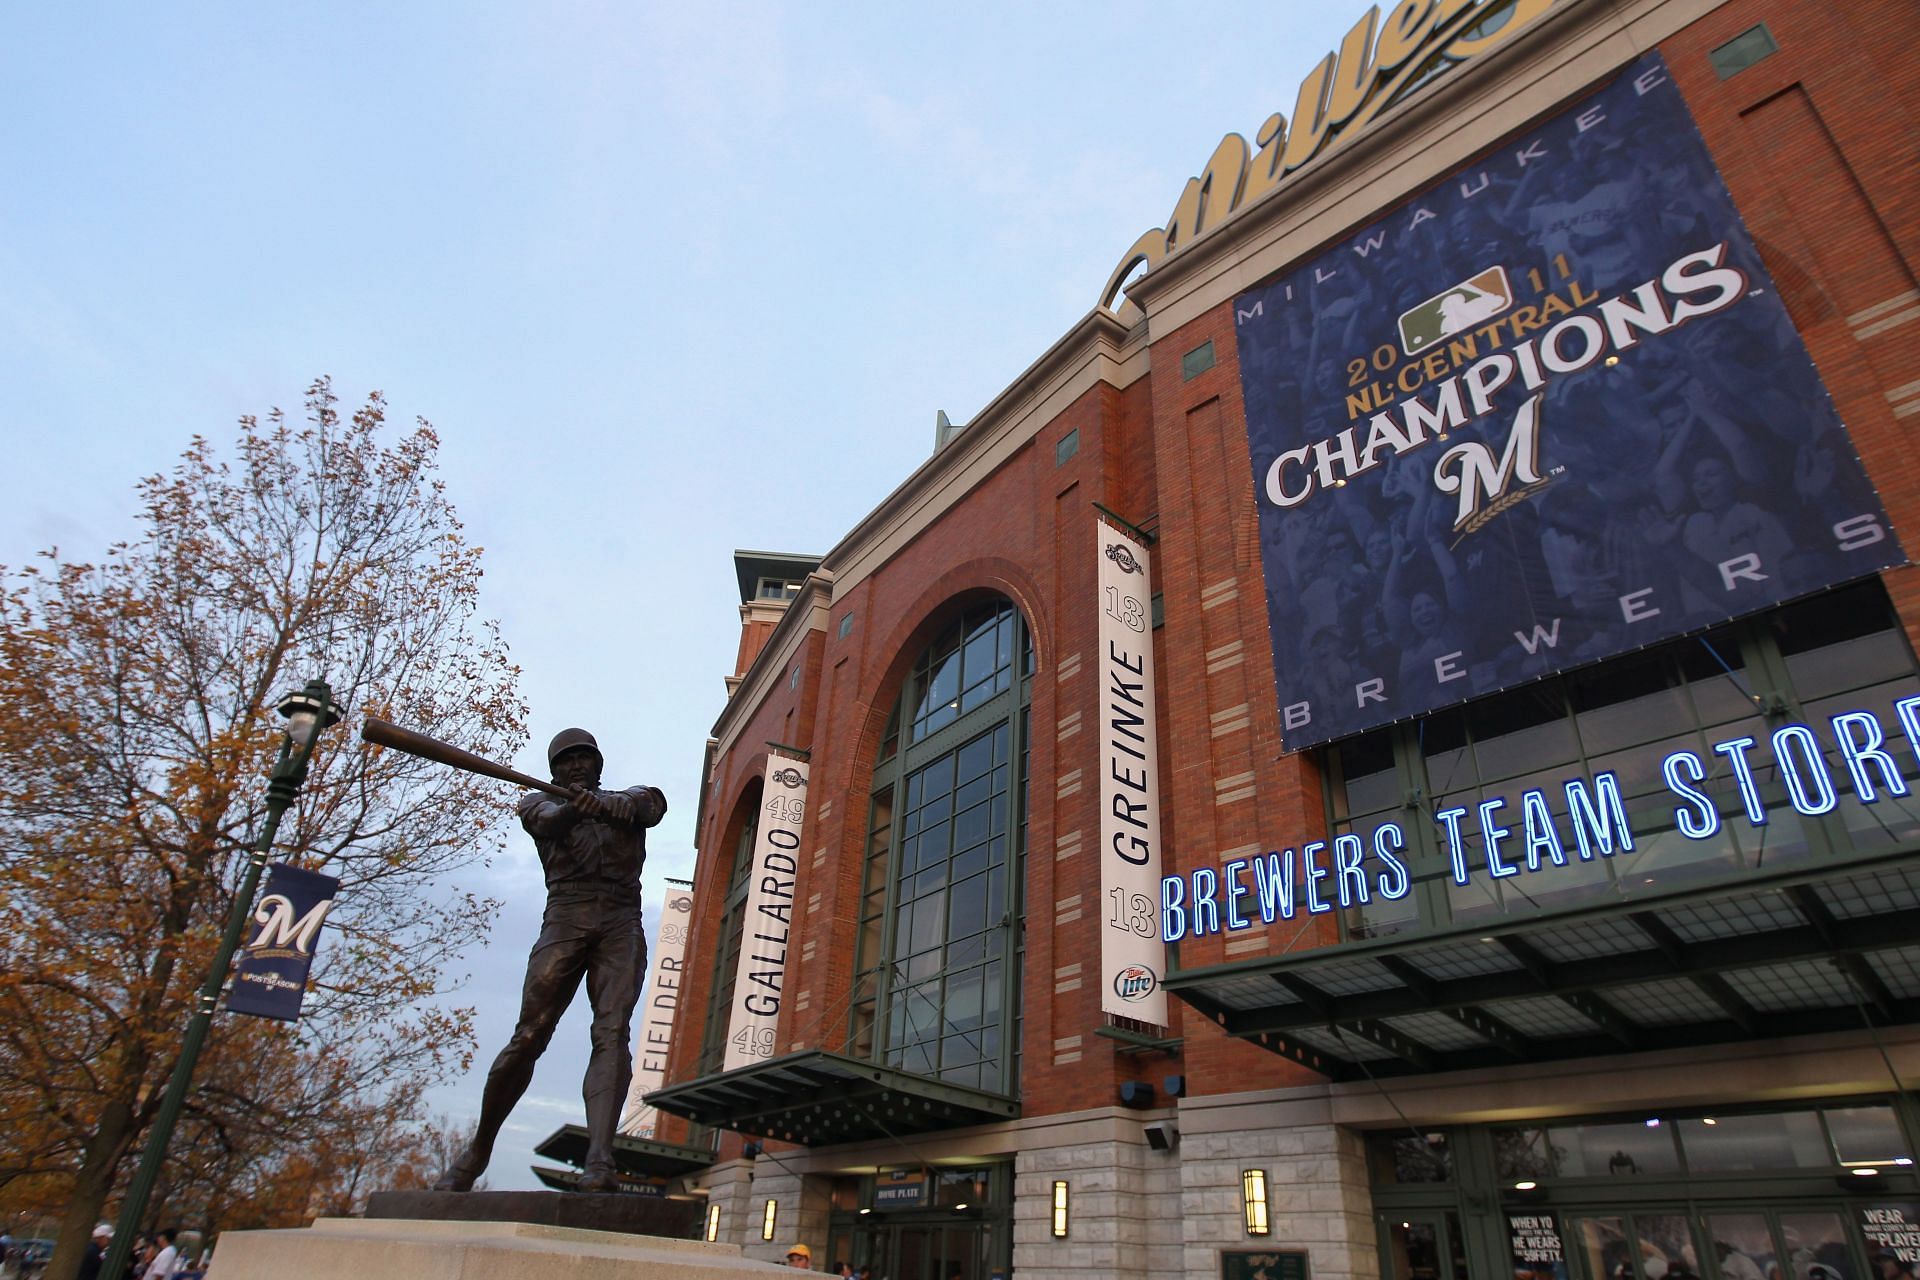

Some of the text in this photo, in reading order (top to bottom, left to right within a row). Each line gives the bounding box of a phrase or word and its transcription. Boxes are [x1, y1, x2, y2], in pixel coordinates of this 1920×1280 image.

[1236, 65, 1667, 326] MILWAUKEE
[1264, 241, 1749, 508] CHAMPIONS
[1434, 391, 1550, 532] M
[1106, 586, 1145, 633] 13
[1284, 513, 1885, 731] BREWERS
[1110, 640, 1150, 867] GREINKE
[766, 796, 805, 825] 49
[1161, 823, 1411, 944] BREWERS
[1437, 771, 1634, 886] TEAM
[744, 828, 800, 1017] GALLARDO
[1110, 887, 1156, 938] 13
[1122, 976, 1151, 998] Lite
[732, 1024, 778, 1058] 49
[1509, 1216, 1538, 1229] WHEN
[1863, 1209, 1905, 1224] WEAR
[1526, 1236, 1561, 1249] WEARS
